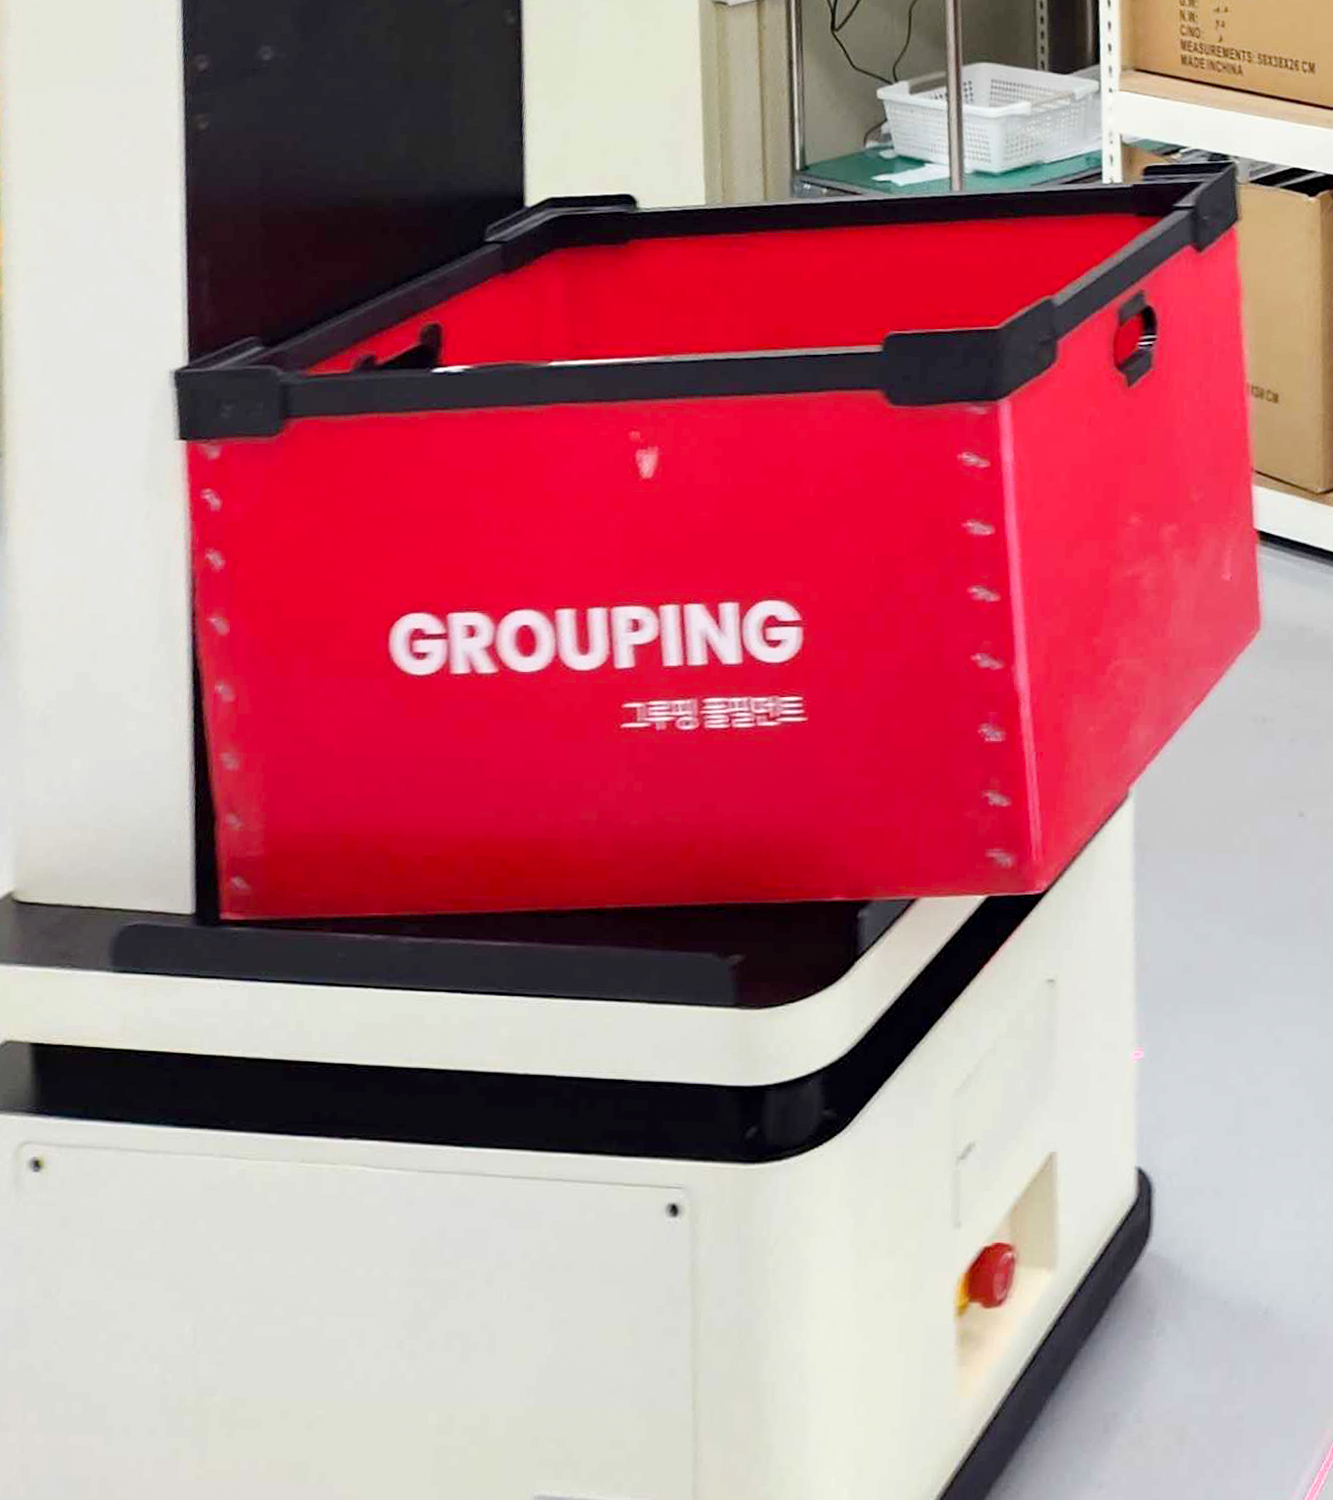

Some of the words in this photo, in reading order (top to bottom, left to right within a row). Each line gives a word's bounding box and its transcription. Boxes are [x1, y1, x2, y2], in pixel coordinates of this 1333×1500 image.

[1180, 38, 1253, 63] MEASUREMENTS:
[1302, 60, 1316, 74] CM
[1180, 54, 1205, 70] MADE
[389, 599, 804, 676] GROUPING
[620, 699, 699, 730] 그루핑
